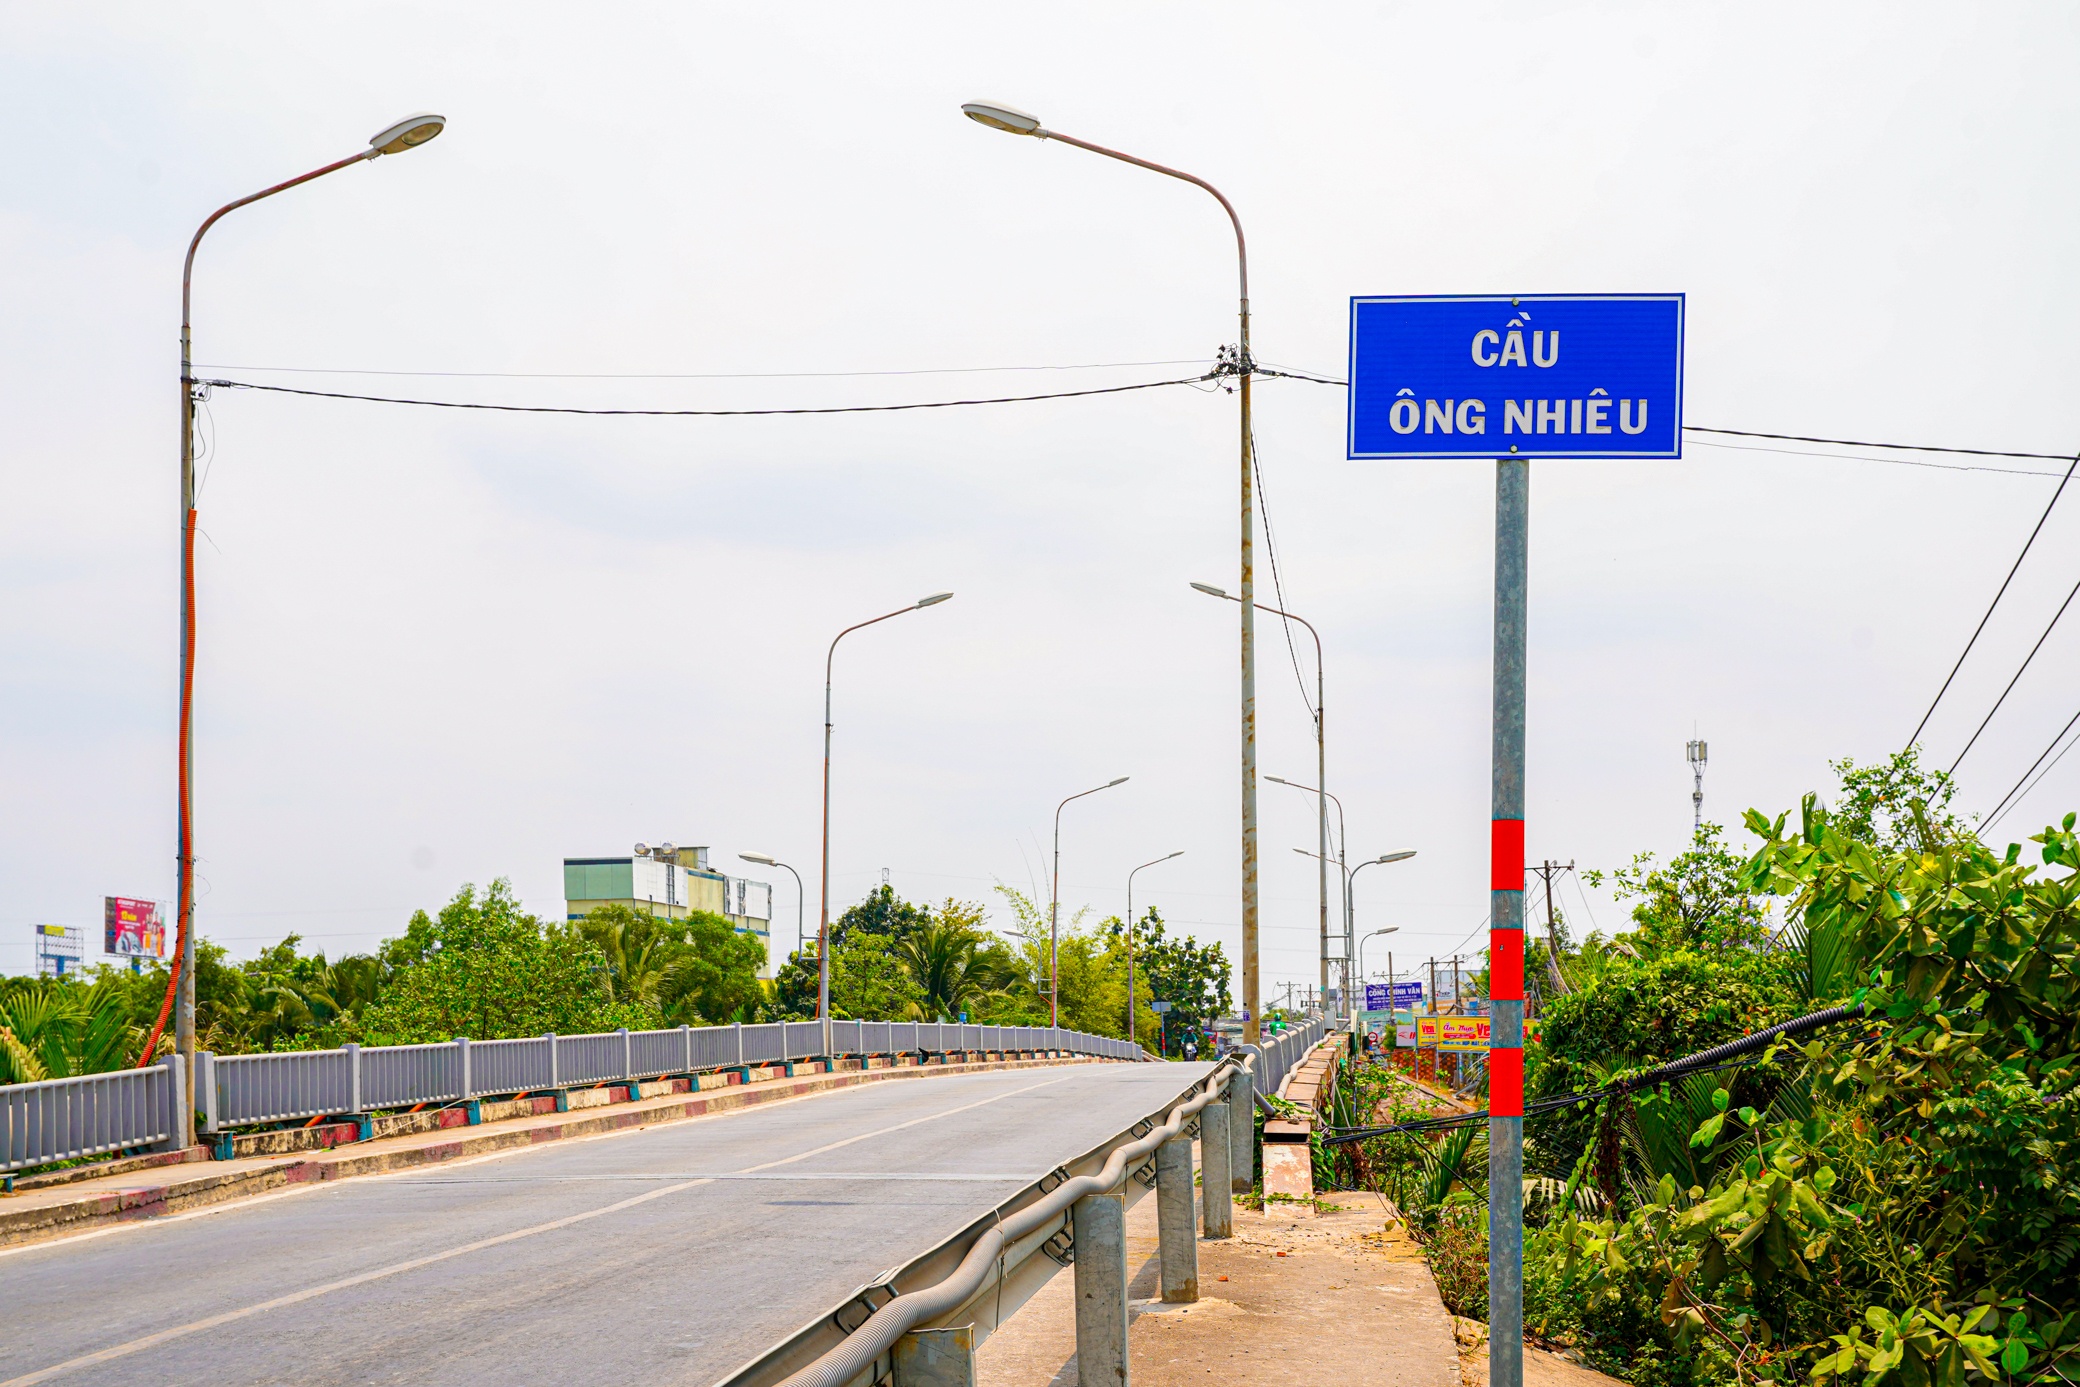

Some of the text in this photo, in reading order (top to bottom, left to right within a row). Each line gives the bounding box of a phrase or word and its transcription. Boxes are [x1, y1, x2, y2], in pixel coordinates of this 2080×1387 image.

[1471, 311, 1559, 368] CẦU
[1389, 387, 1648, 435] ÔNG NHIÊU
